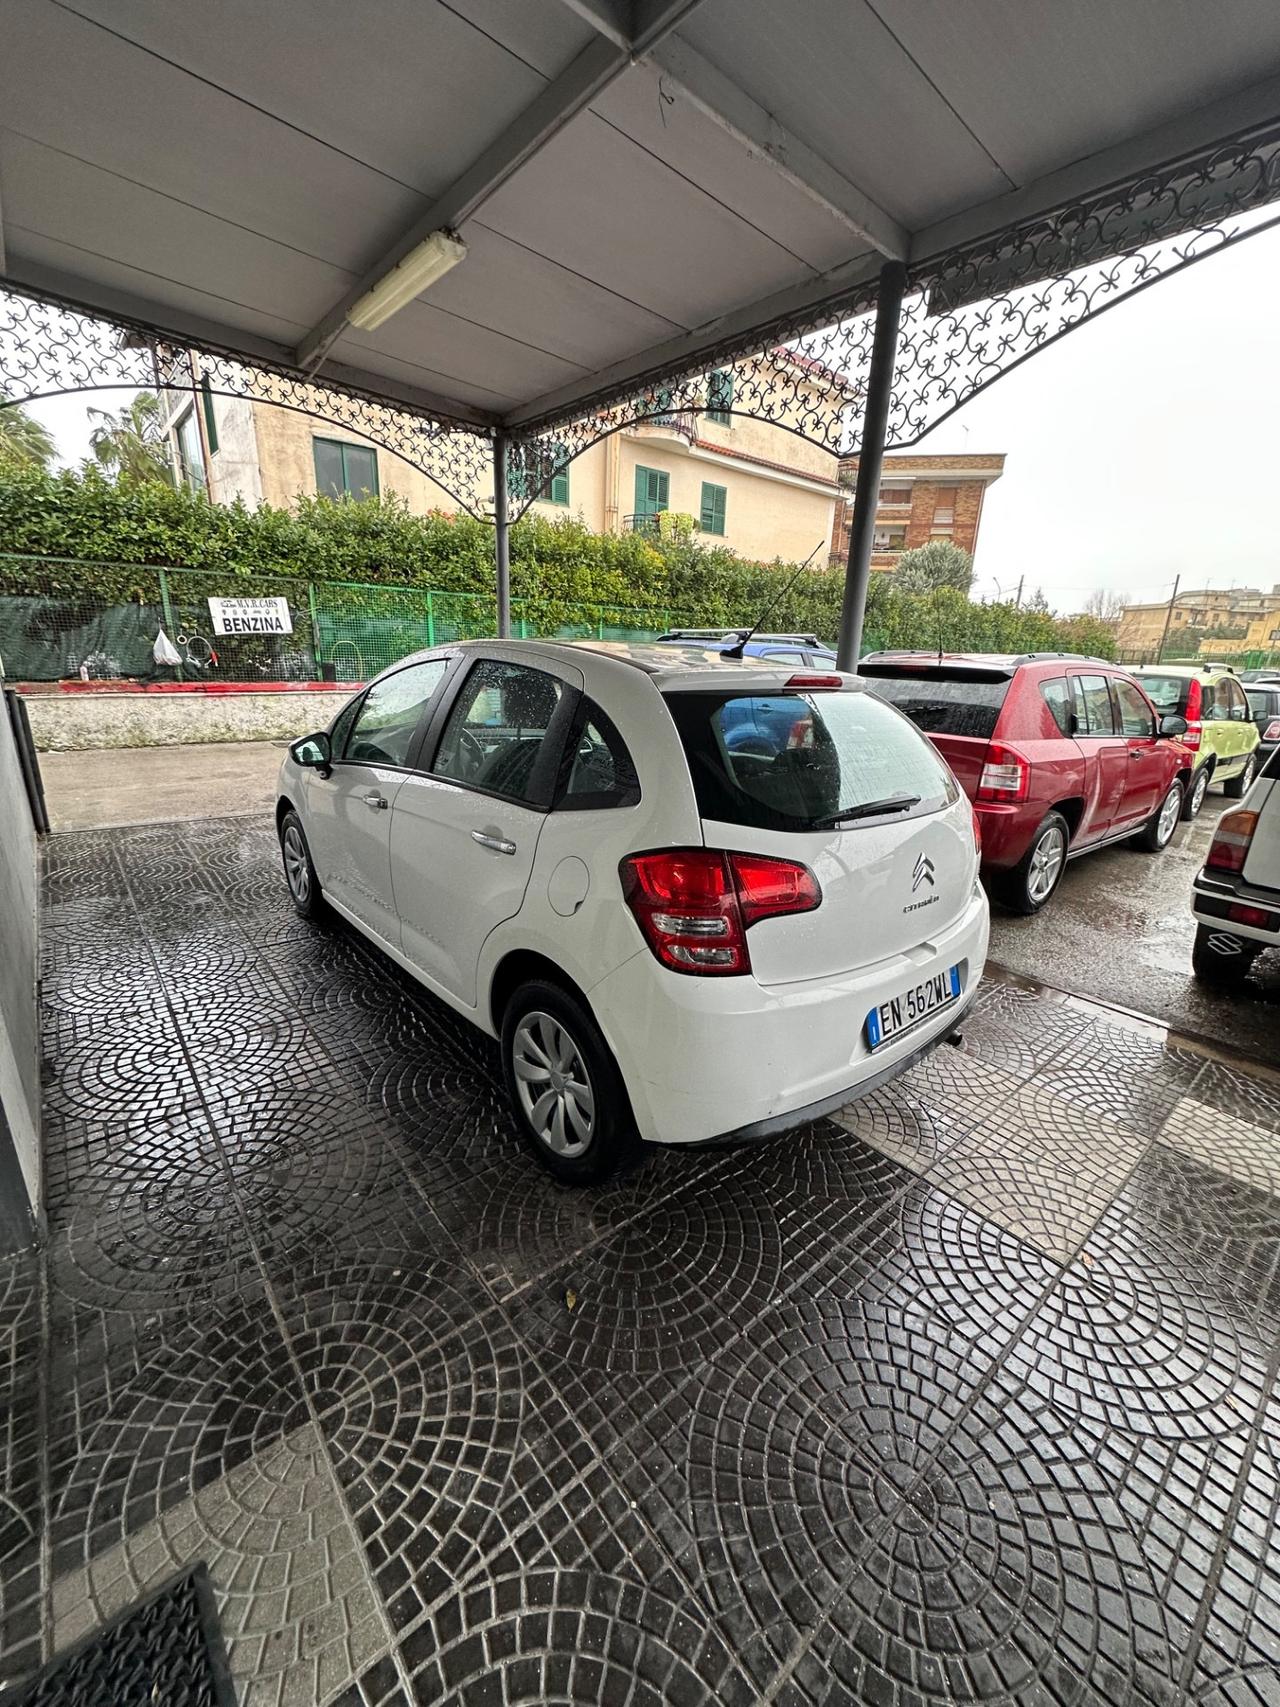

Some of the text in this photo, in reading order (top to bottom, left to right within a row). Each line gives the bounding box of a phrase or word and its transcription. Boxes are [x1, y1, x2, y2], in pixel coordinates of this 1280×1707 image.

[222, 617, 284, 632] BENZINA
[880, 997, 902, 1036] EN
[907, 972, 951, 1019] 562WL
